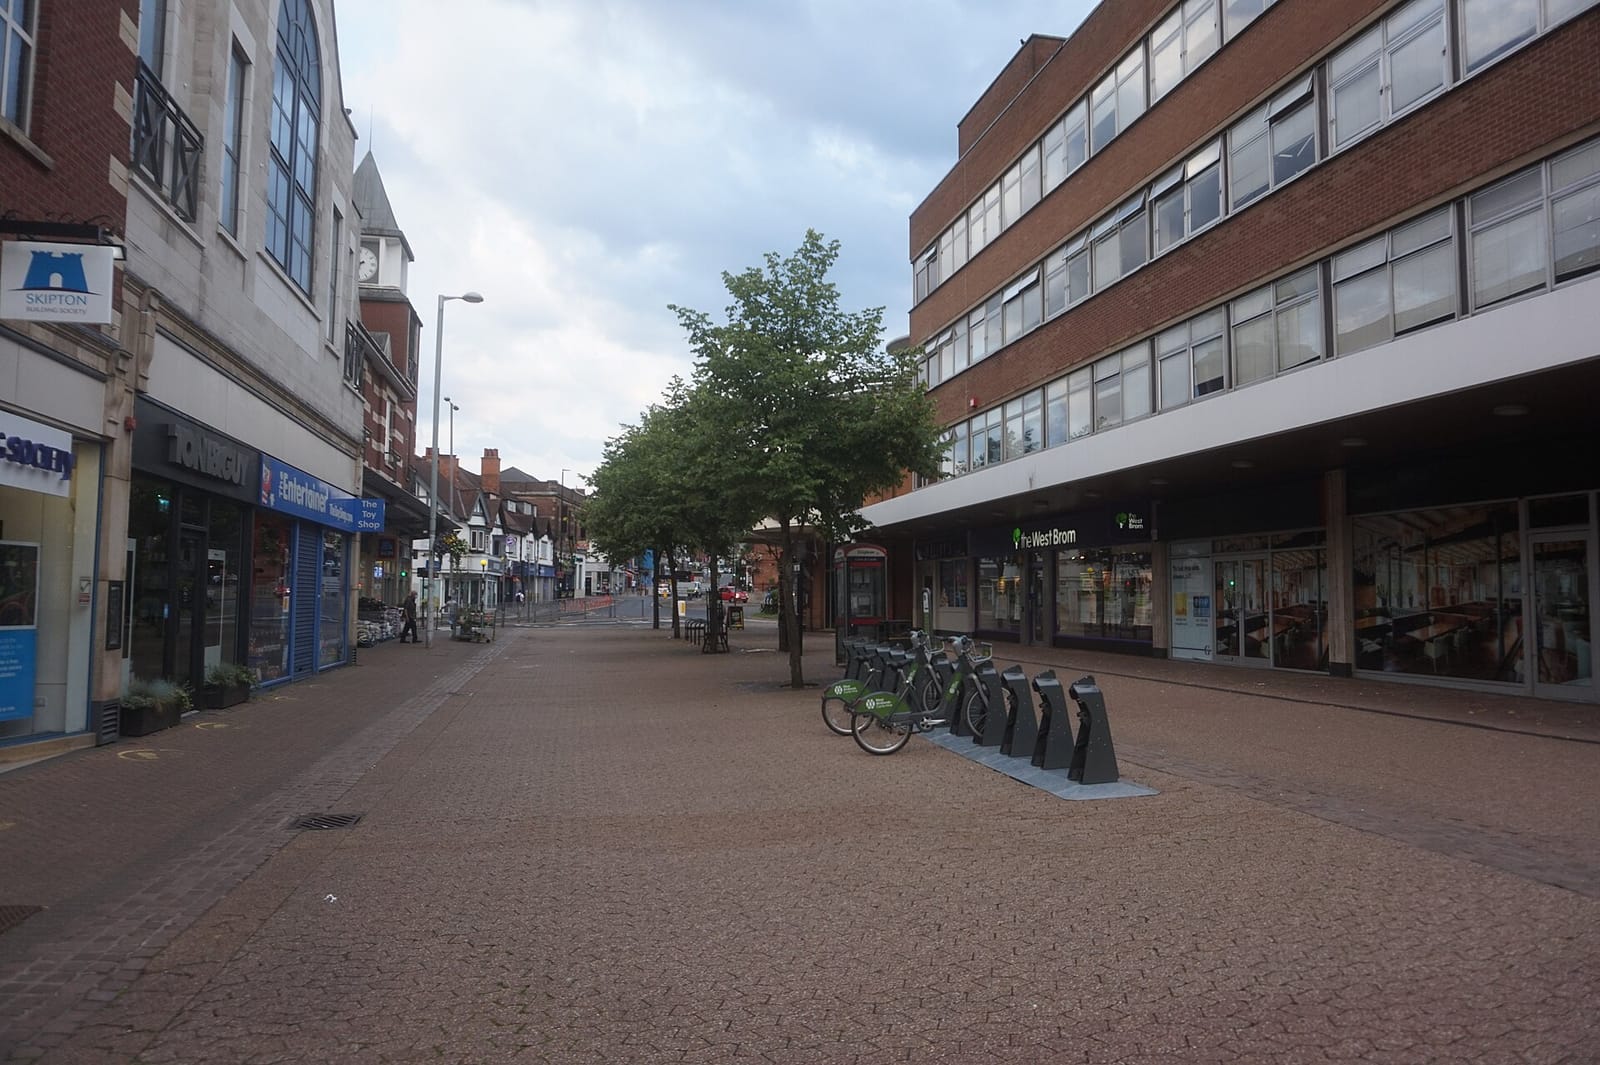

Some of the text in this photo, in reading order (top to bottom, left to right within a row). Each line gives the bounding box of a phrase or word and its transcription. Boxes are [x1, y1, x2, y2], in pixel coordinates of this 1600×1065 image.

[26, 293, 87, 305] SKIPTON
[282, 473, 328, 513] Entertainer
[362, 500, 377, 509] The
[362, 510, 377, 520] Toy
[358, 521, 380, 530] Shop
[1021, 528, 1076, 549] the West Brom
